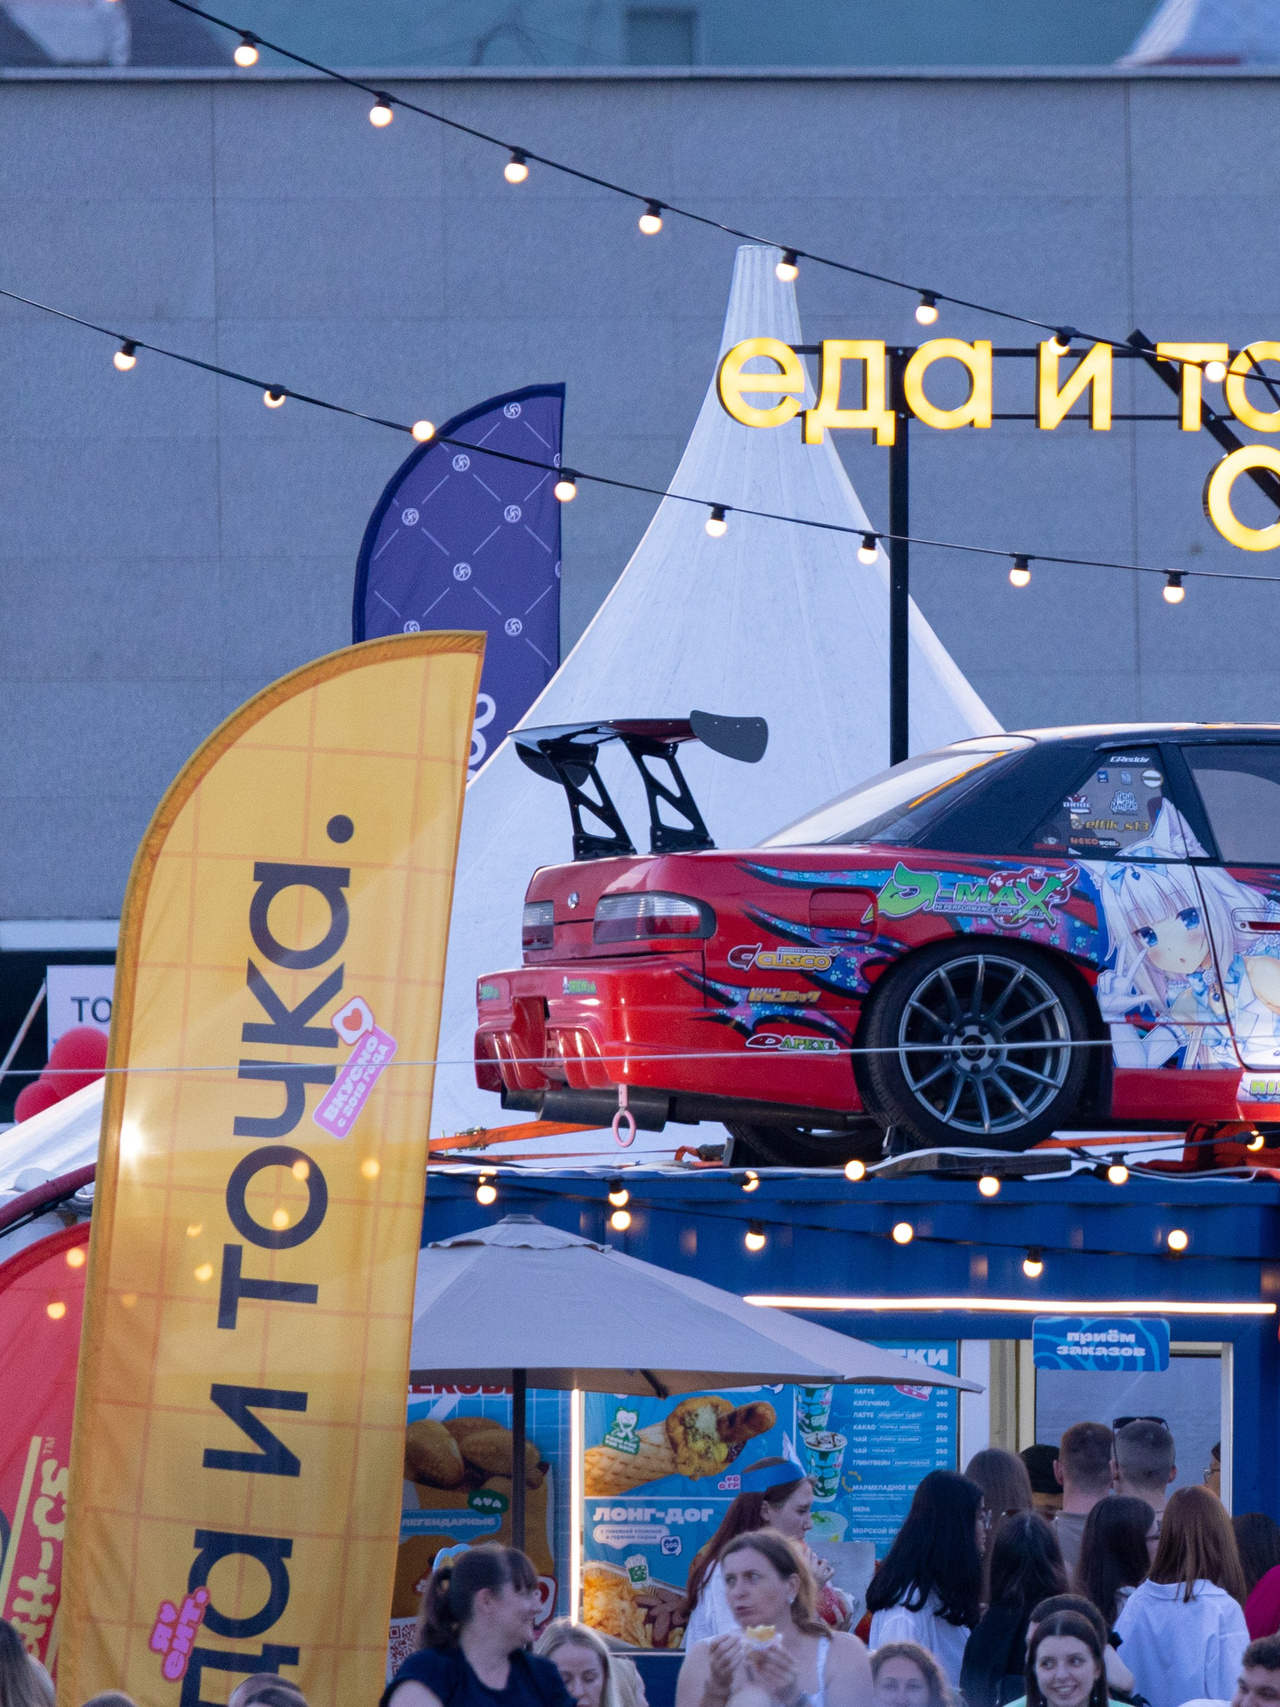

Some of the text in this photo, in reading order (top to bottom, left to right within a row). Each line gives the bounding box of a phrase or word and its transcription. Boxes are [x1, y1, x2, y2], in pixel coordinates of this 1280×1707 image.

[717, 337, 992, 445] еда
[1036, 342, 1113, 431] и
[217, 814, 355, 1331] точка.
[1056, 1345, 1146, 1357] заказов
[1066, 1328, 1136, 1344] приём
[202, 1383, 309, 1478] и
[593, 1507, 714, 1525] ЛОНГ-ДОГ
